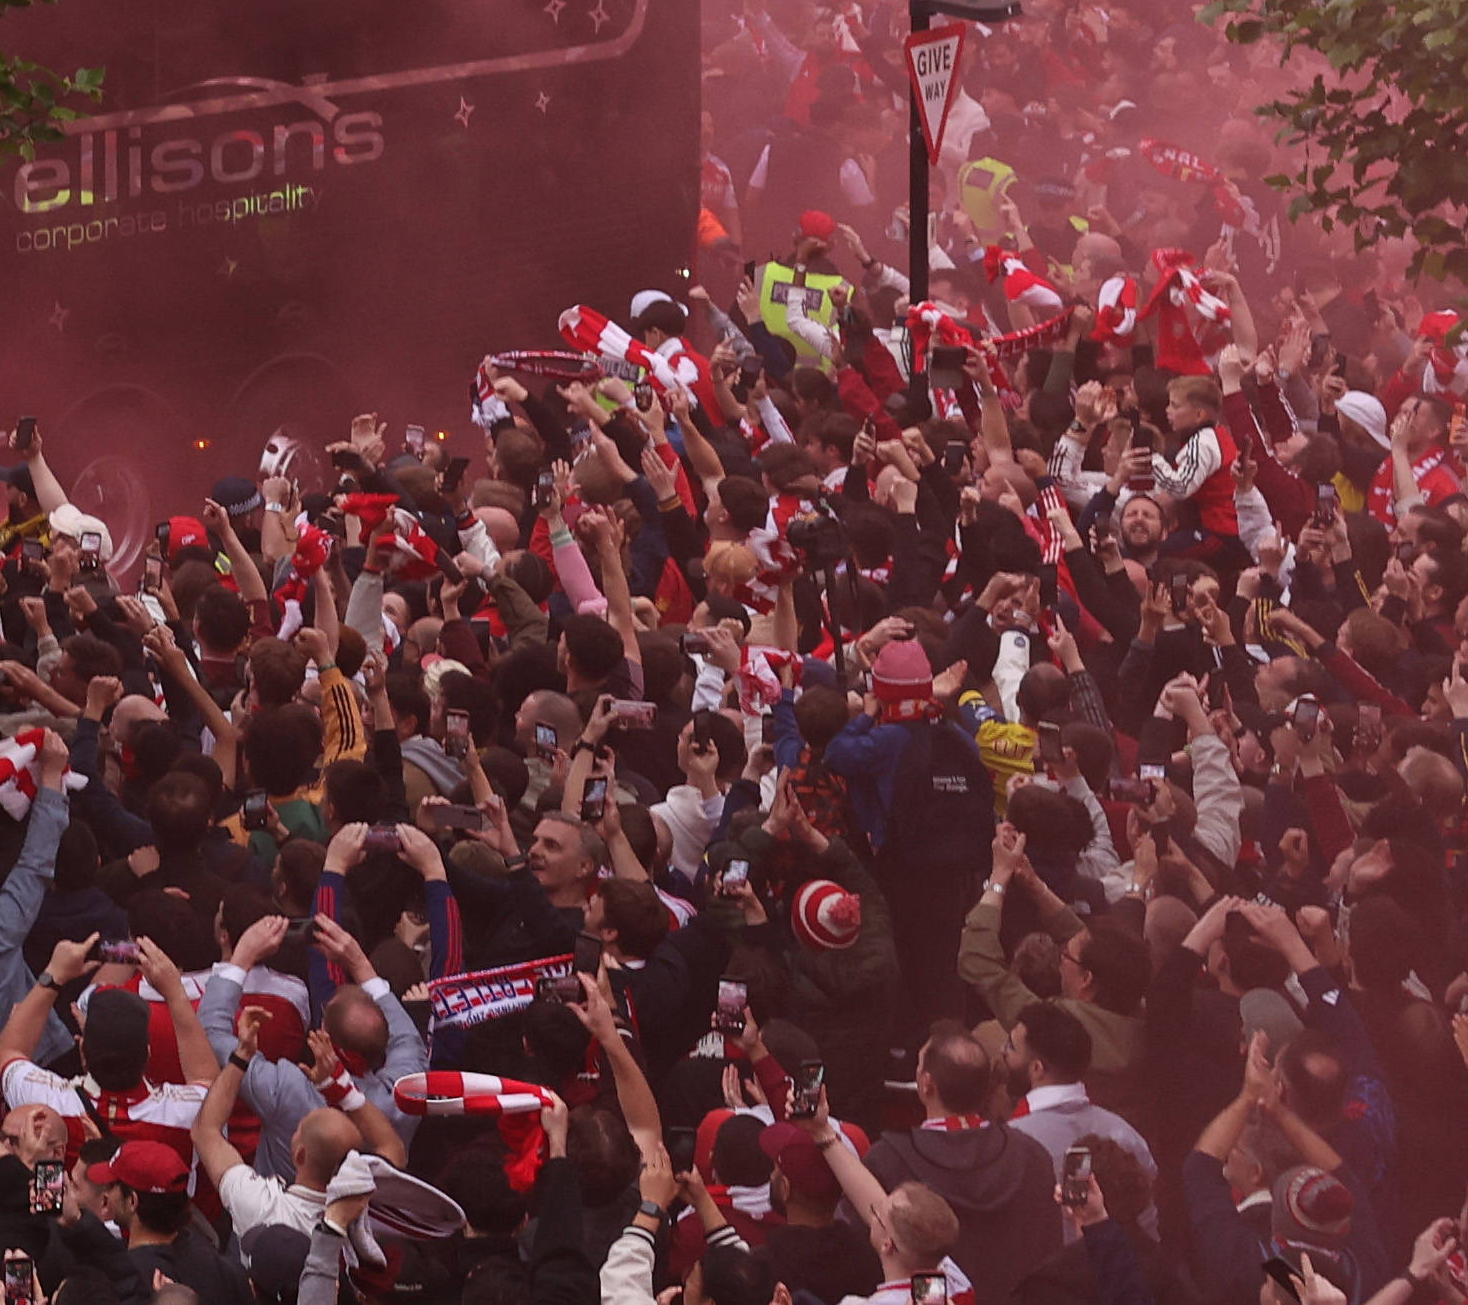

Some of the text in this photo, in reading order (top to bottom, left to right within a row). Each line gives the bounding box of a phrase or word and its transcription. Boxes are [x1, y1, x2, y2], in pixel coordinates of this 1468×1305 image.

[916, 44, 951, 77] GIVE
[925, 81, 946, 101] WAY
[14, 109, 385, 215] ellisons
[15, 182, 325, 254] corporate hospitality
[433, 979, 517, 1020] ATLET
